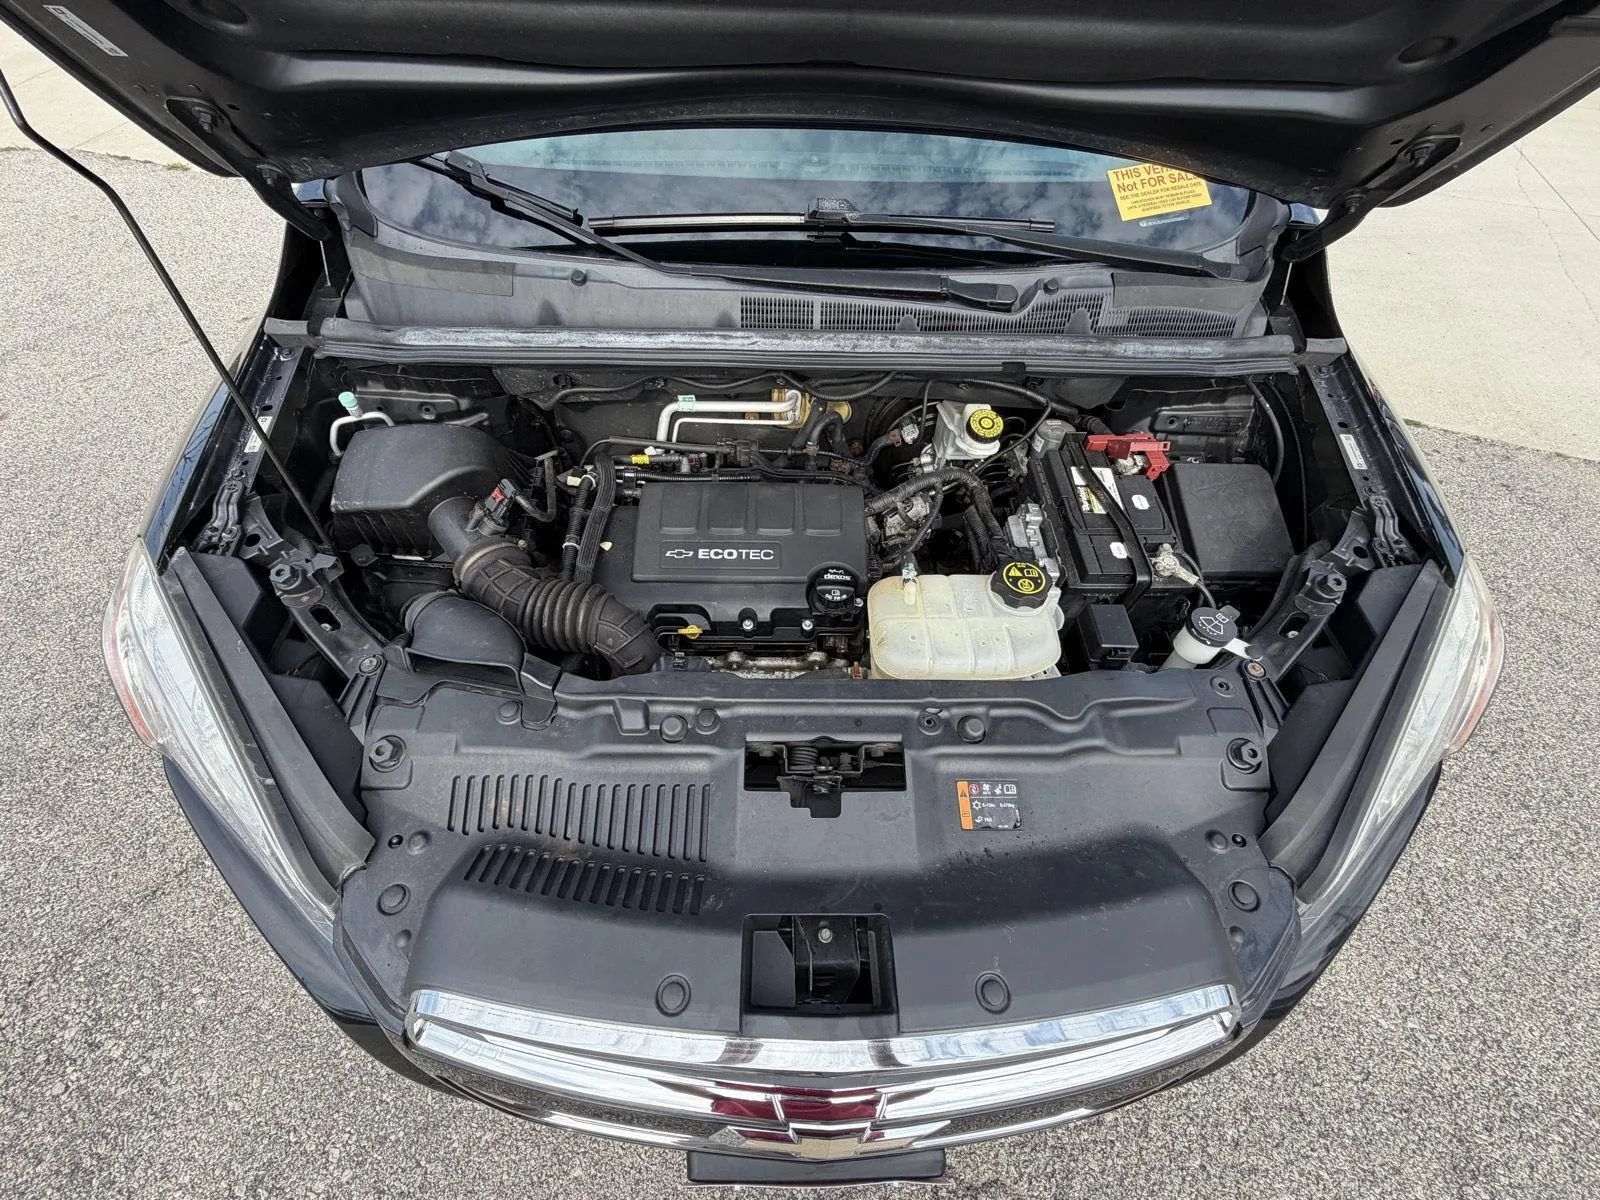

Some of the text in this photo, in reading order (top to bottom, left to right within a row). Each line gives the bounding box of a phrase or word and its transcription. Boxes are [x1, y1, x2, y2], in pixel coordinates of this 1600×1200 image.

[1113, 168, 1141, 181] THIS
[1117, 181, 1138, 193] Not
[1140, 176, 1166, 188] FOR
[698, 548, 774, 560] ECOTEC
[823, 573, 851, 581] dexos
